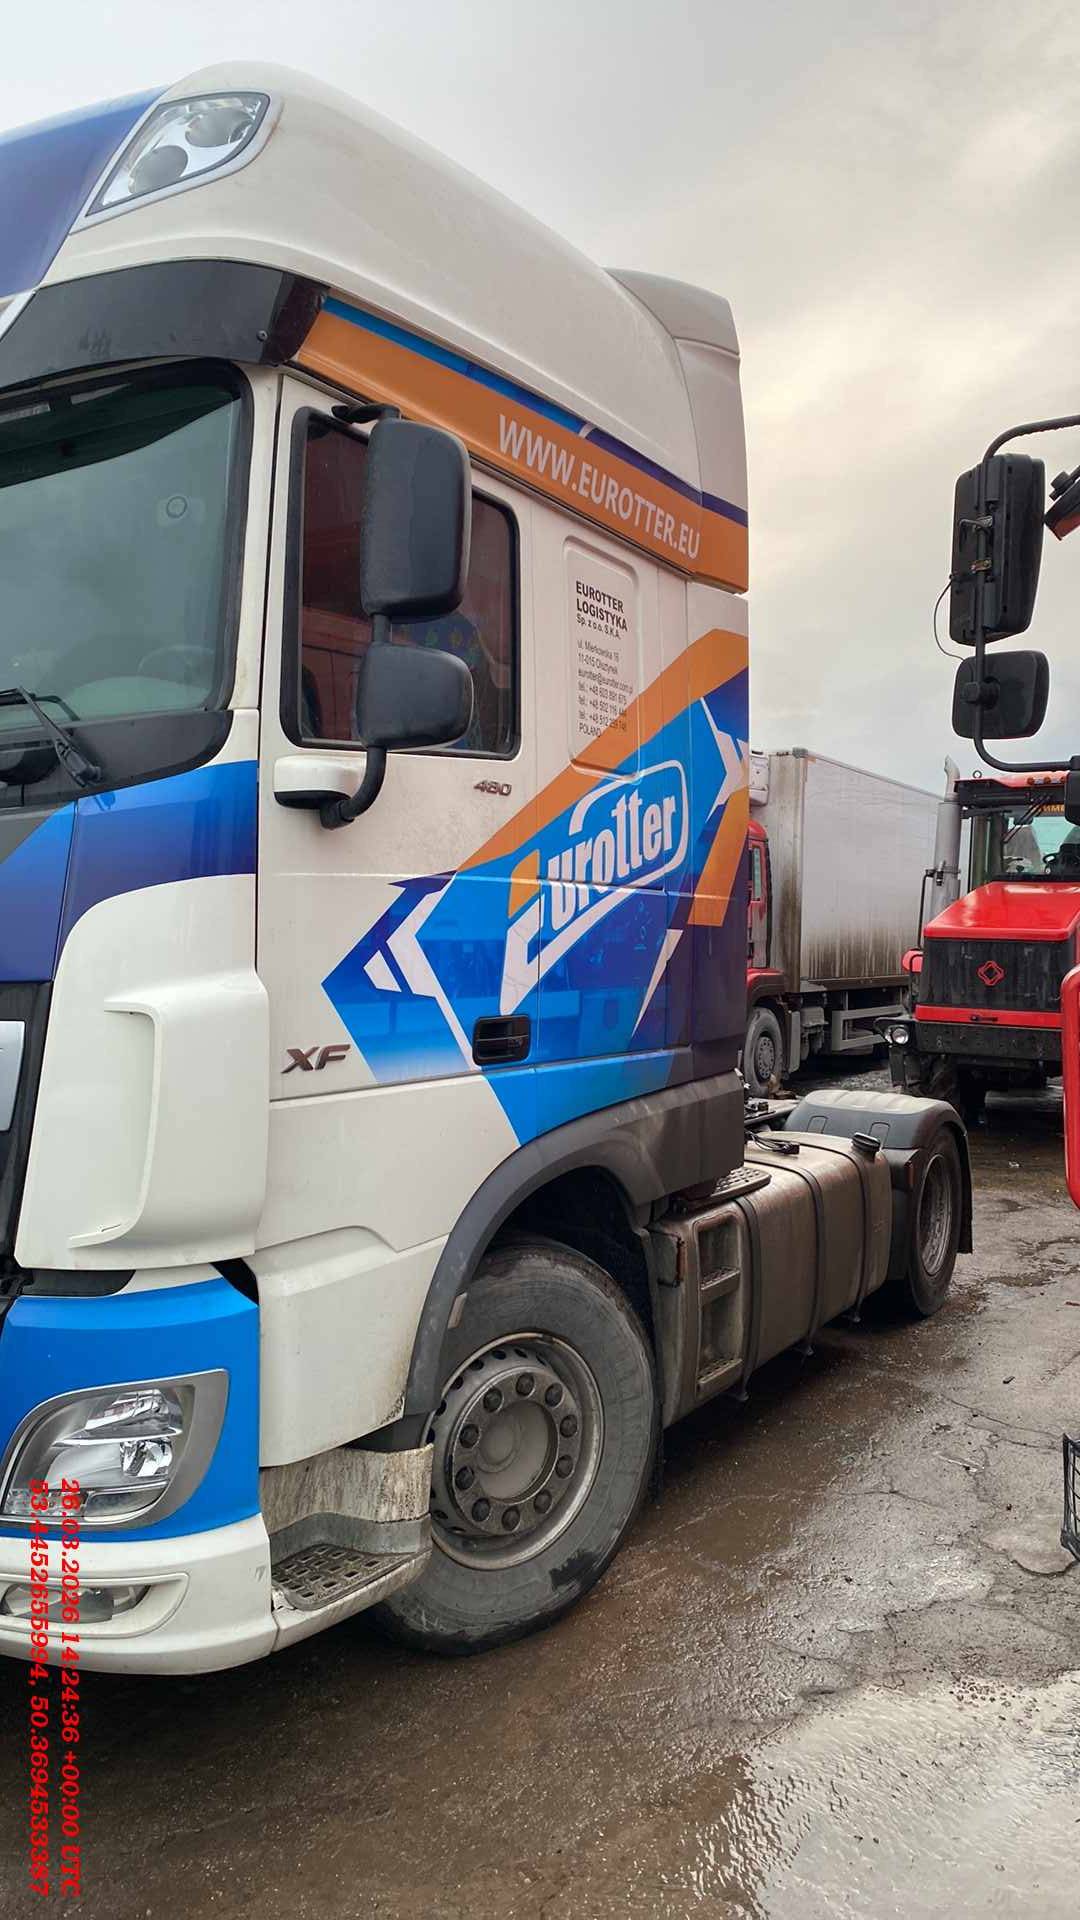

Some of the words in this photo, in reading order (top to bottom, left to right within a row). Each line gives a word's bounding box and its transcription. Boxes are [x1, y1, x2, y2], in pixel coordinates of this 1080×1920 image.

[499, 413, 701, 560] WWW.EUROTTER.EU
[576, 580, 624, 614] EUROTTER
[576, 598, 628, 632] LOGISTYKA
[576, 612, 586, 626] Sp.
[281, 1044, 351, 1074] XF
